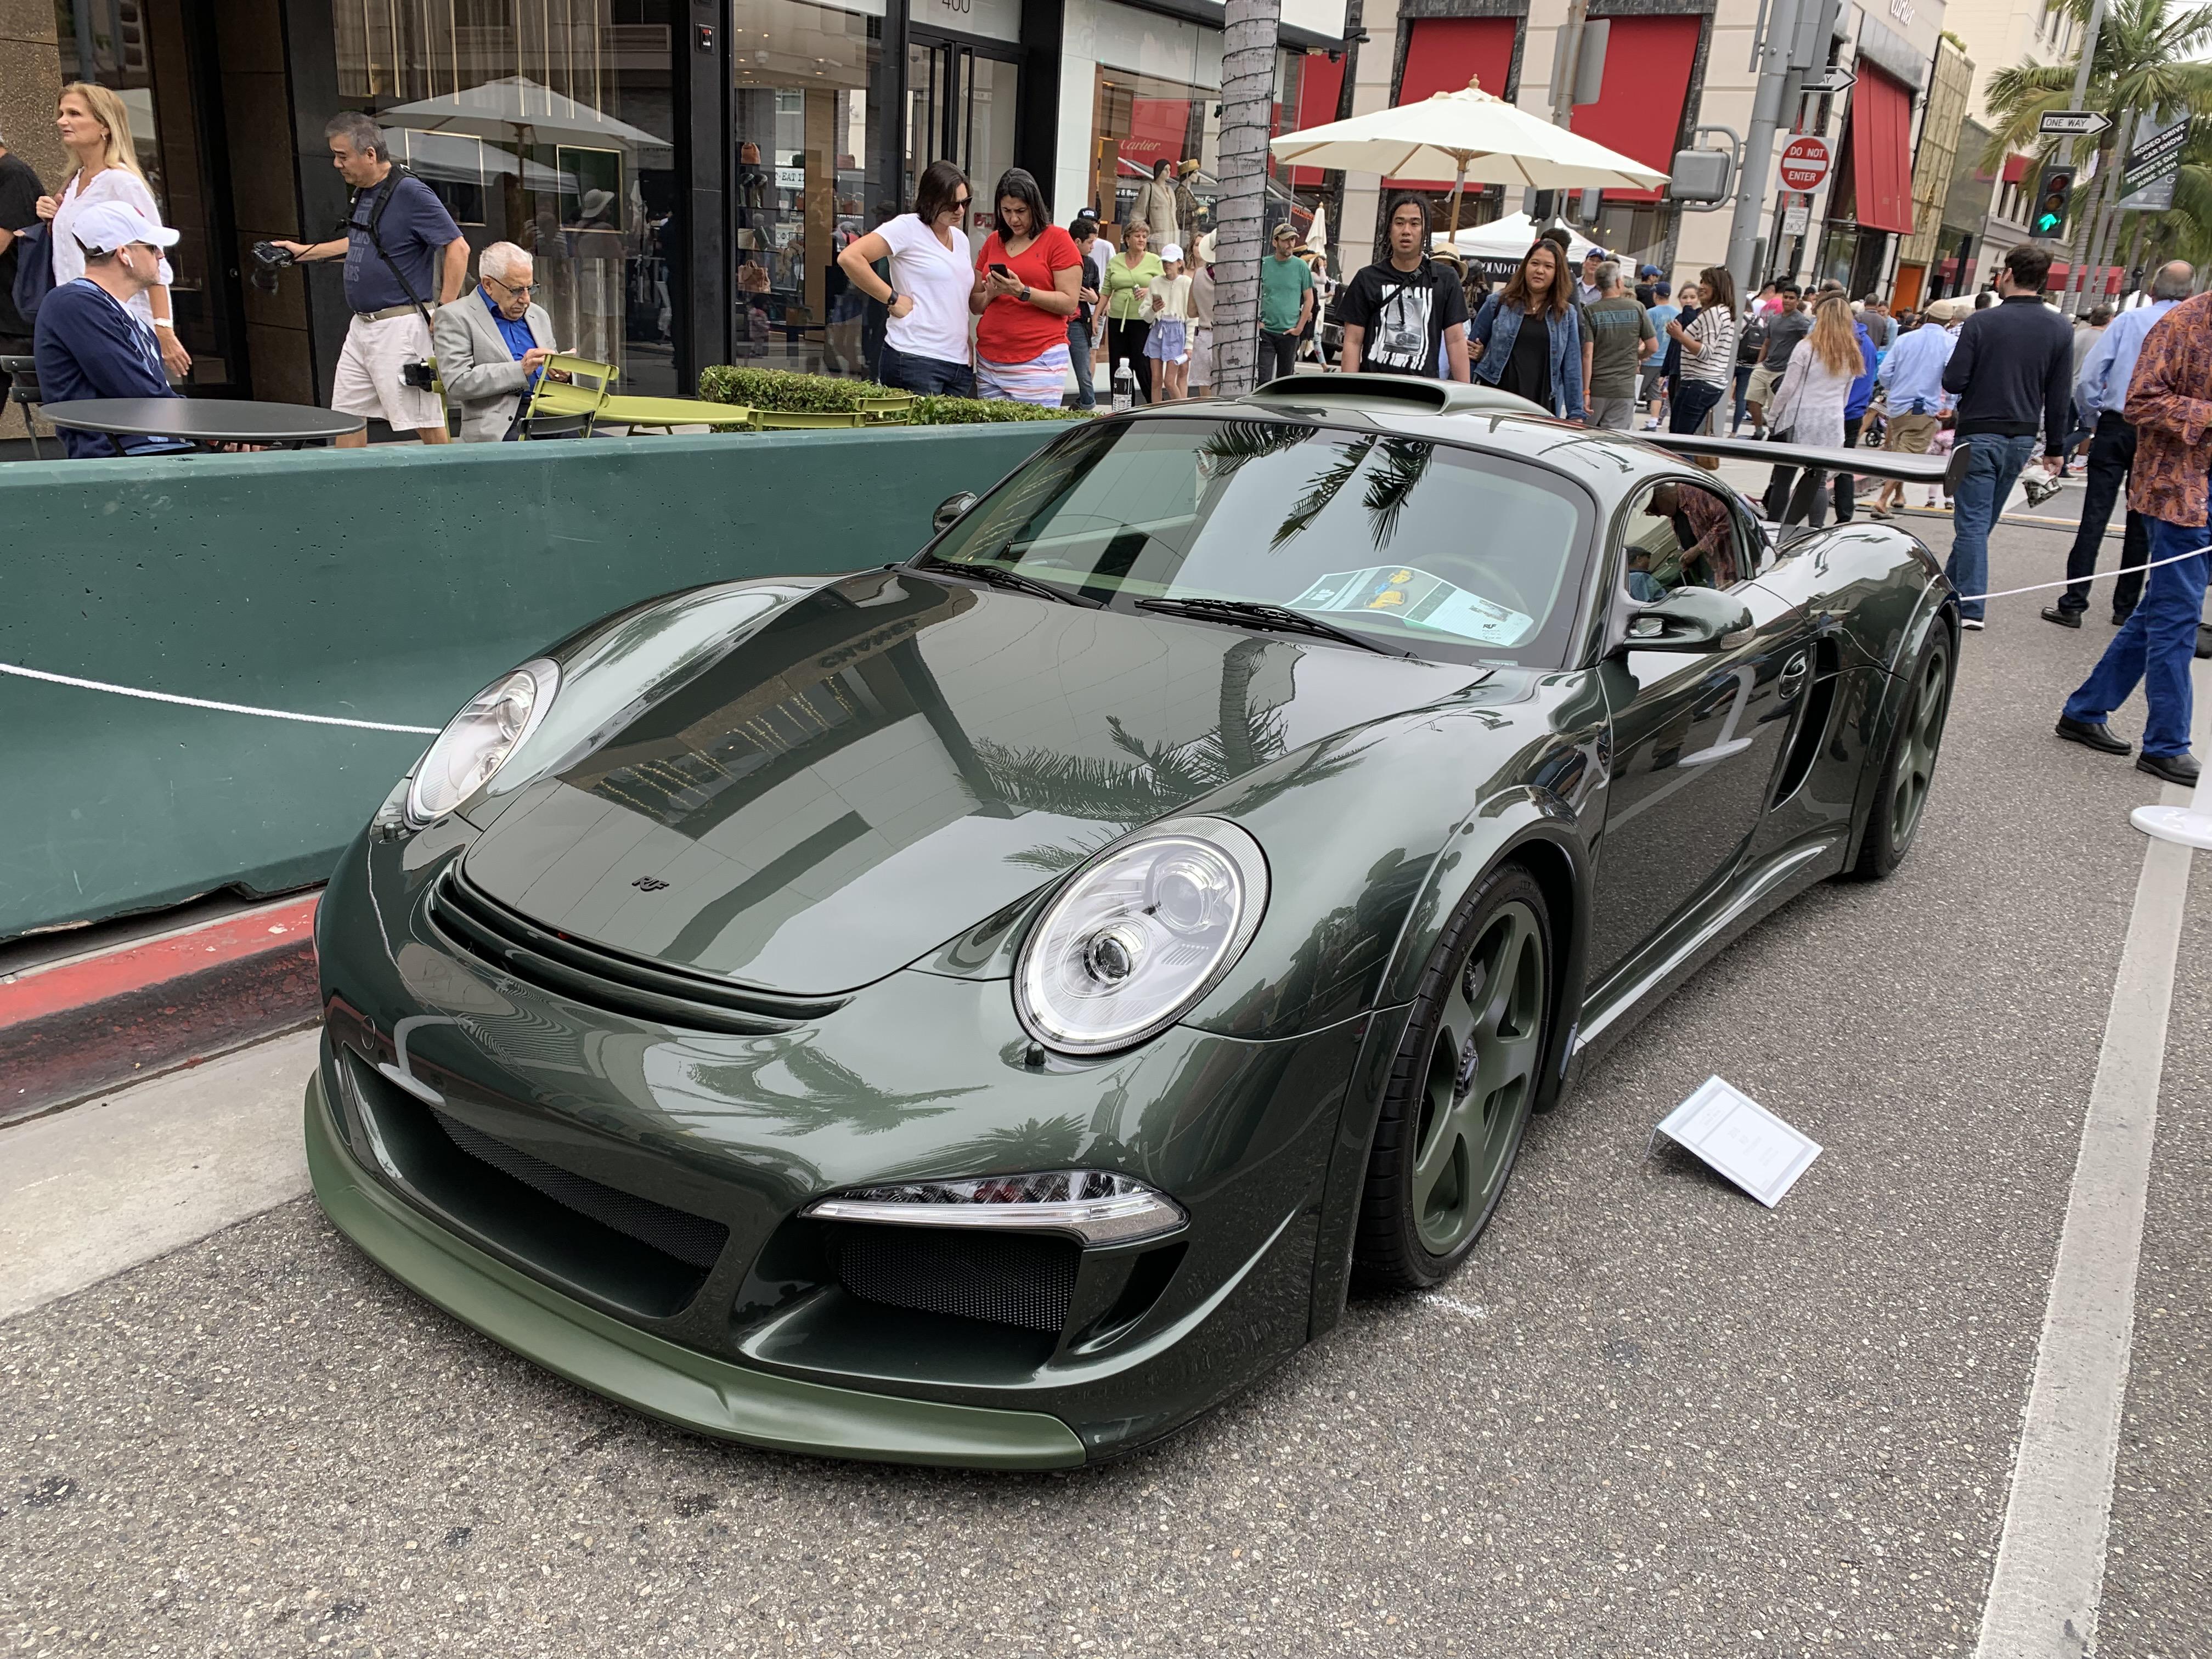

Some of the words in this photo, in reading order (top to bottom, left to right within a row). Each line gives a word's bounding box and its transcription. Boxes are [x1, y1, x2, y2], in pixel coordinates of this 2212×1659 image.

[2046, 119, 2064, 127] ONE
[2068, 119, 2087, 127] WAY
[1120, 139, 1161, 151] Cartier
[2134, 138, 2161, 156] RODEO
[2162, 123, 2186, 140] DRIVE
[2142, 149, 2159, 160] CAR
[2159, 133, 2183, 151] SHOW
[1790, 146, 1803, 156] DO
[1807, 148, 1825, 158] NOT
[2127, 160, 2163, 184] FATHER'S
[2163, 150, 2179, 163] DAY
[2137, 172, 2157, 188] JUNE
[2158, 161, 2178, 175] 16TH
[1788, 171, 1816, 182] ENTER
[631, 876, 670, 892] RUF
